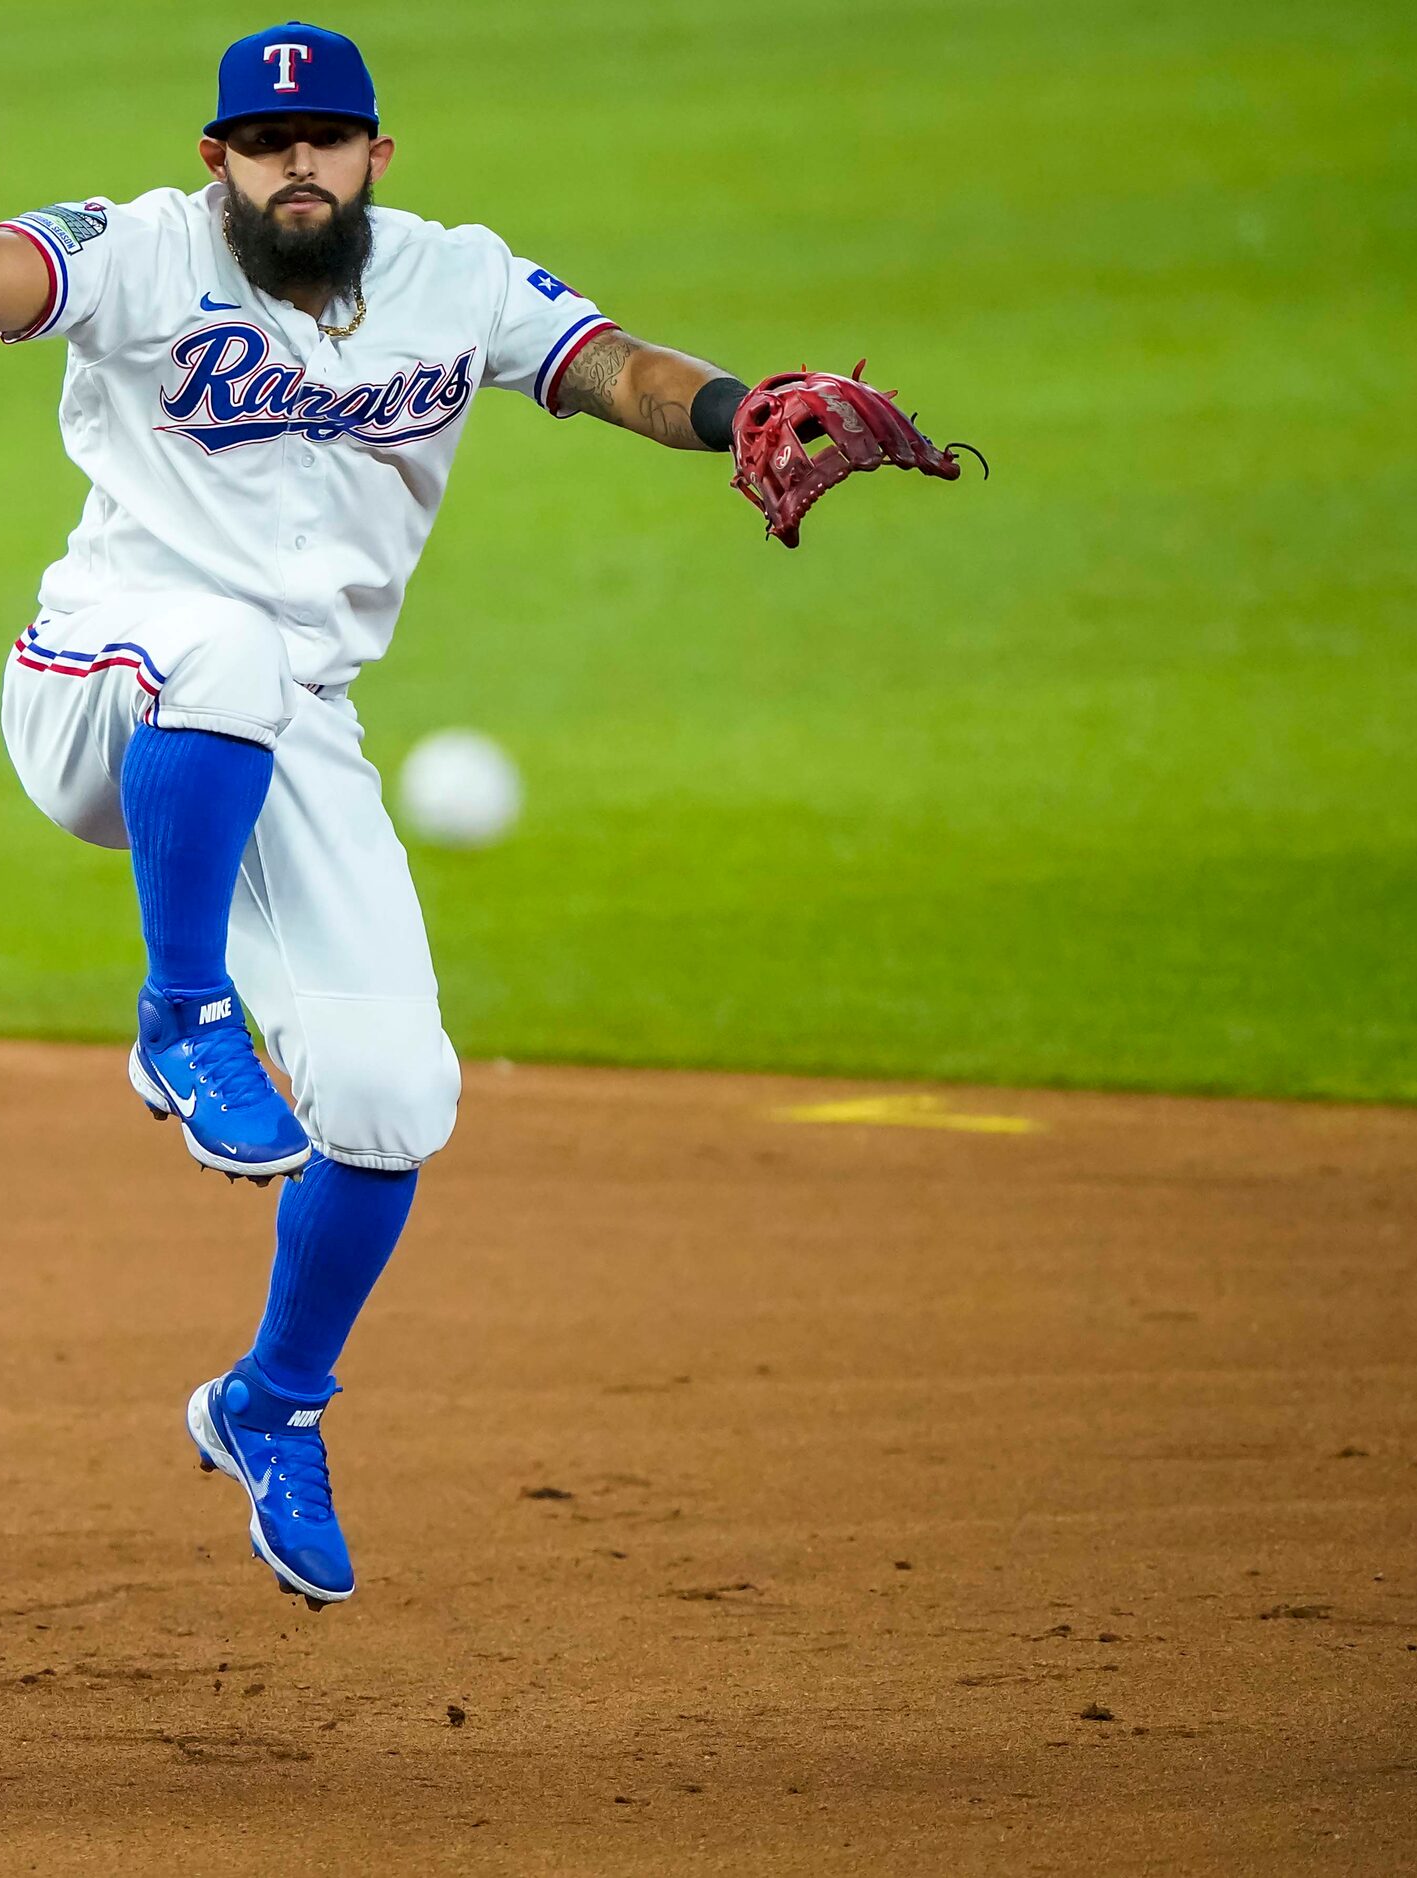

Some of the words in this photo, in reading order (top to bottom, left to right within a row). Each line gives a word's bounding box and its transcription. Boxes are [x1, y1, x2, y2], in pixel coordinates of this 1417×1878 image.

[263, 43, 312, 94] T
[50, 224, 76, 250] SEASON
[158, 320, 477, 444] Rangers
[198, 996, 232, 1025] NIKE
